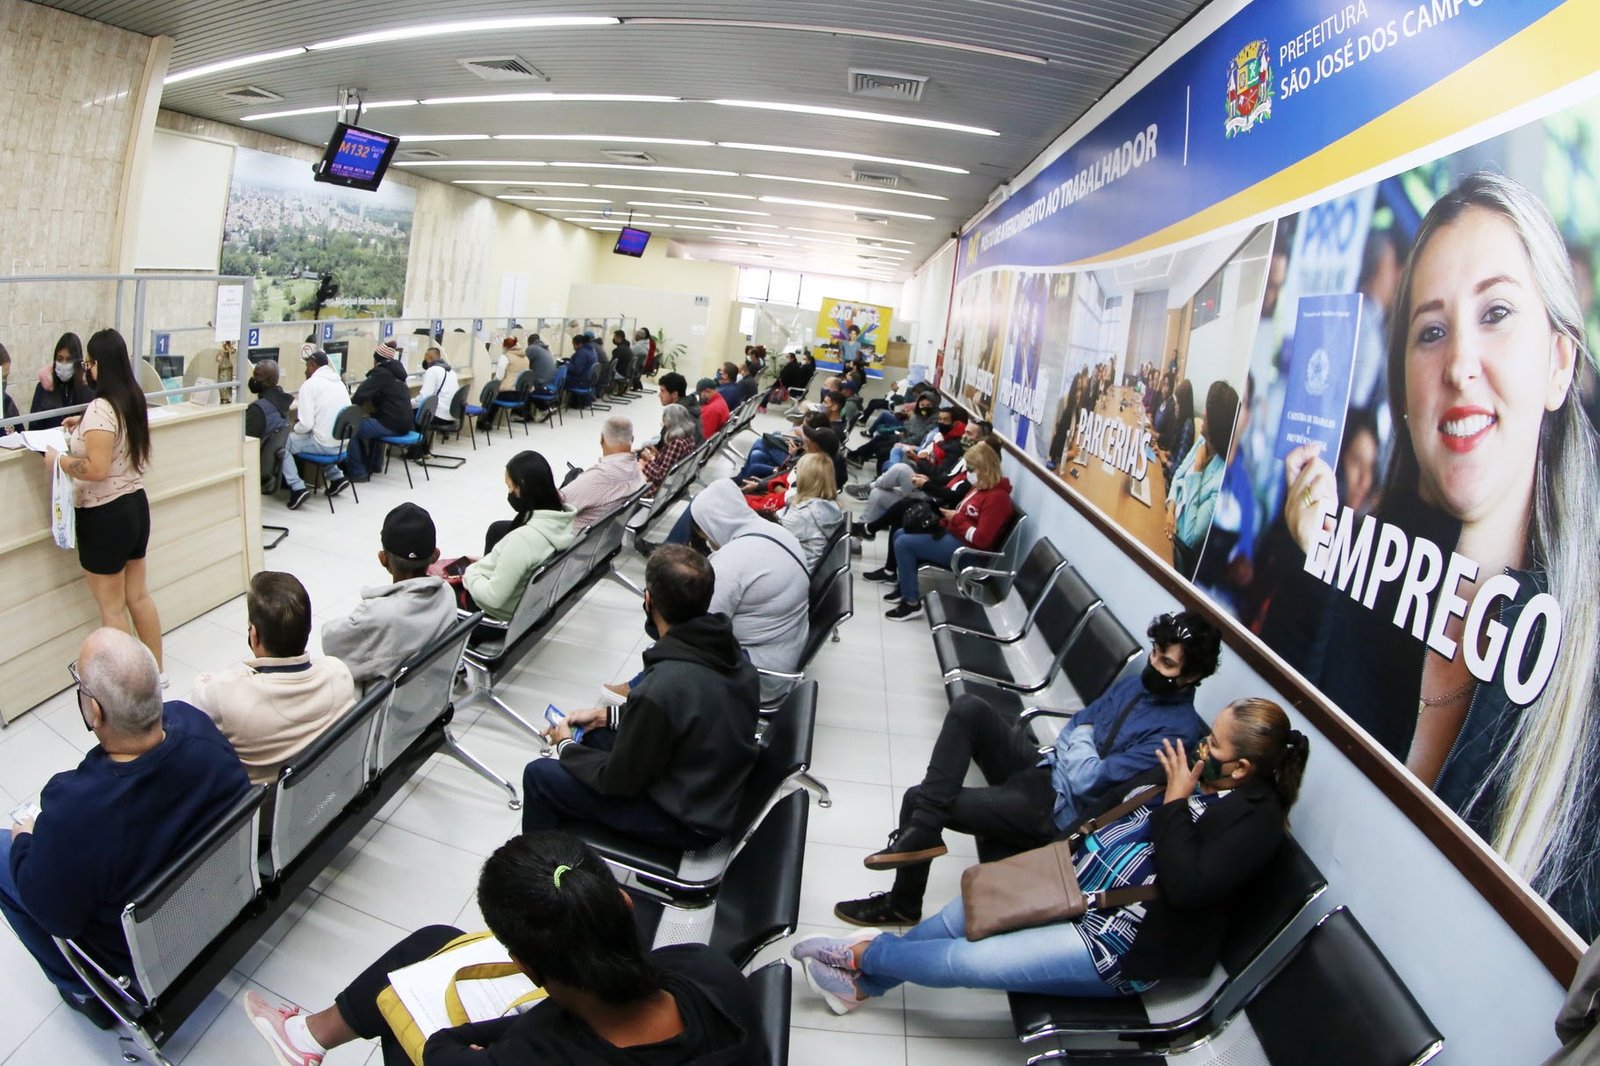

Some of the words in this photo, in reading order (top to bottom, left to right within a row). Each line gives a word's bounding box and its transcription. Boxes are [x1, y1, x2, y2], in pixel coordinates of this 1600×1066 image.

[1280, 0, 1369, 67] PREFEITURA
[1281, 66, 1311, 100] SÃO
[1313, 38, 1354, 84] JOSÉ
[1358, 20, 1398, 62] DOS
[1402, 0, 1484, 38] CAMP
[339, 141, 370, 158] M132
[1045, 187, 1060, 218] AO
[1061, 123, 1158, 208] TRABALHADOR
[160, 338, 165, 352] 1
[250, 330, 257, 345] 2
[325, 327, 331, 338] 3
[386, 324, 391, 335] 4
[1076, 407, 1152, 481] PARCERIAS
[1304, 497, 1562, 706] EMPREGO
